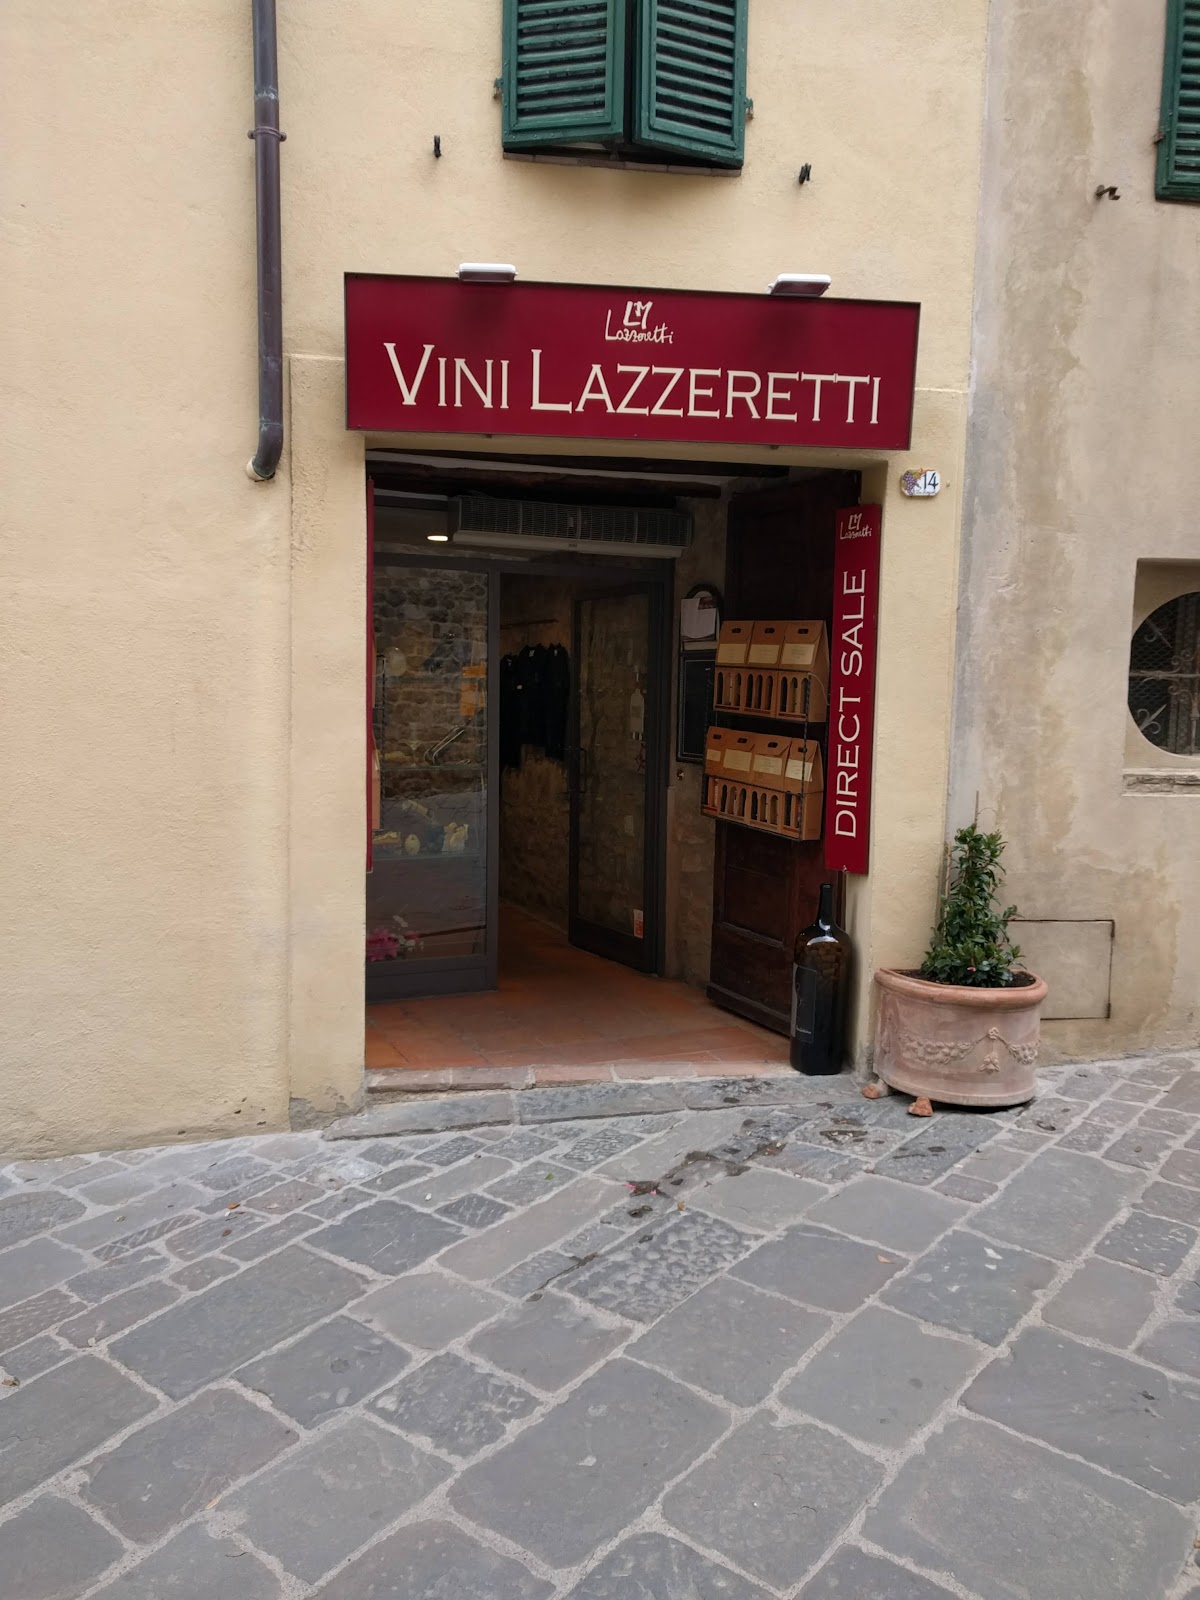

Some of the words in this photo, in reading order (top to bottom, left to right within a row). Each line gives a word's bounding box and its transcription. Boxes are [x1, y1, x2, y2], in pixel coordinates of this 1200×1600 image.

[383, 342, 510, 409] VINI
[530, 349, 881, 424] LAZZERETTI
[922, 472, 938, 490] 14
[841, 569, 866, 677] SALE
[835, 687, 861, 838] DIRECT
